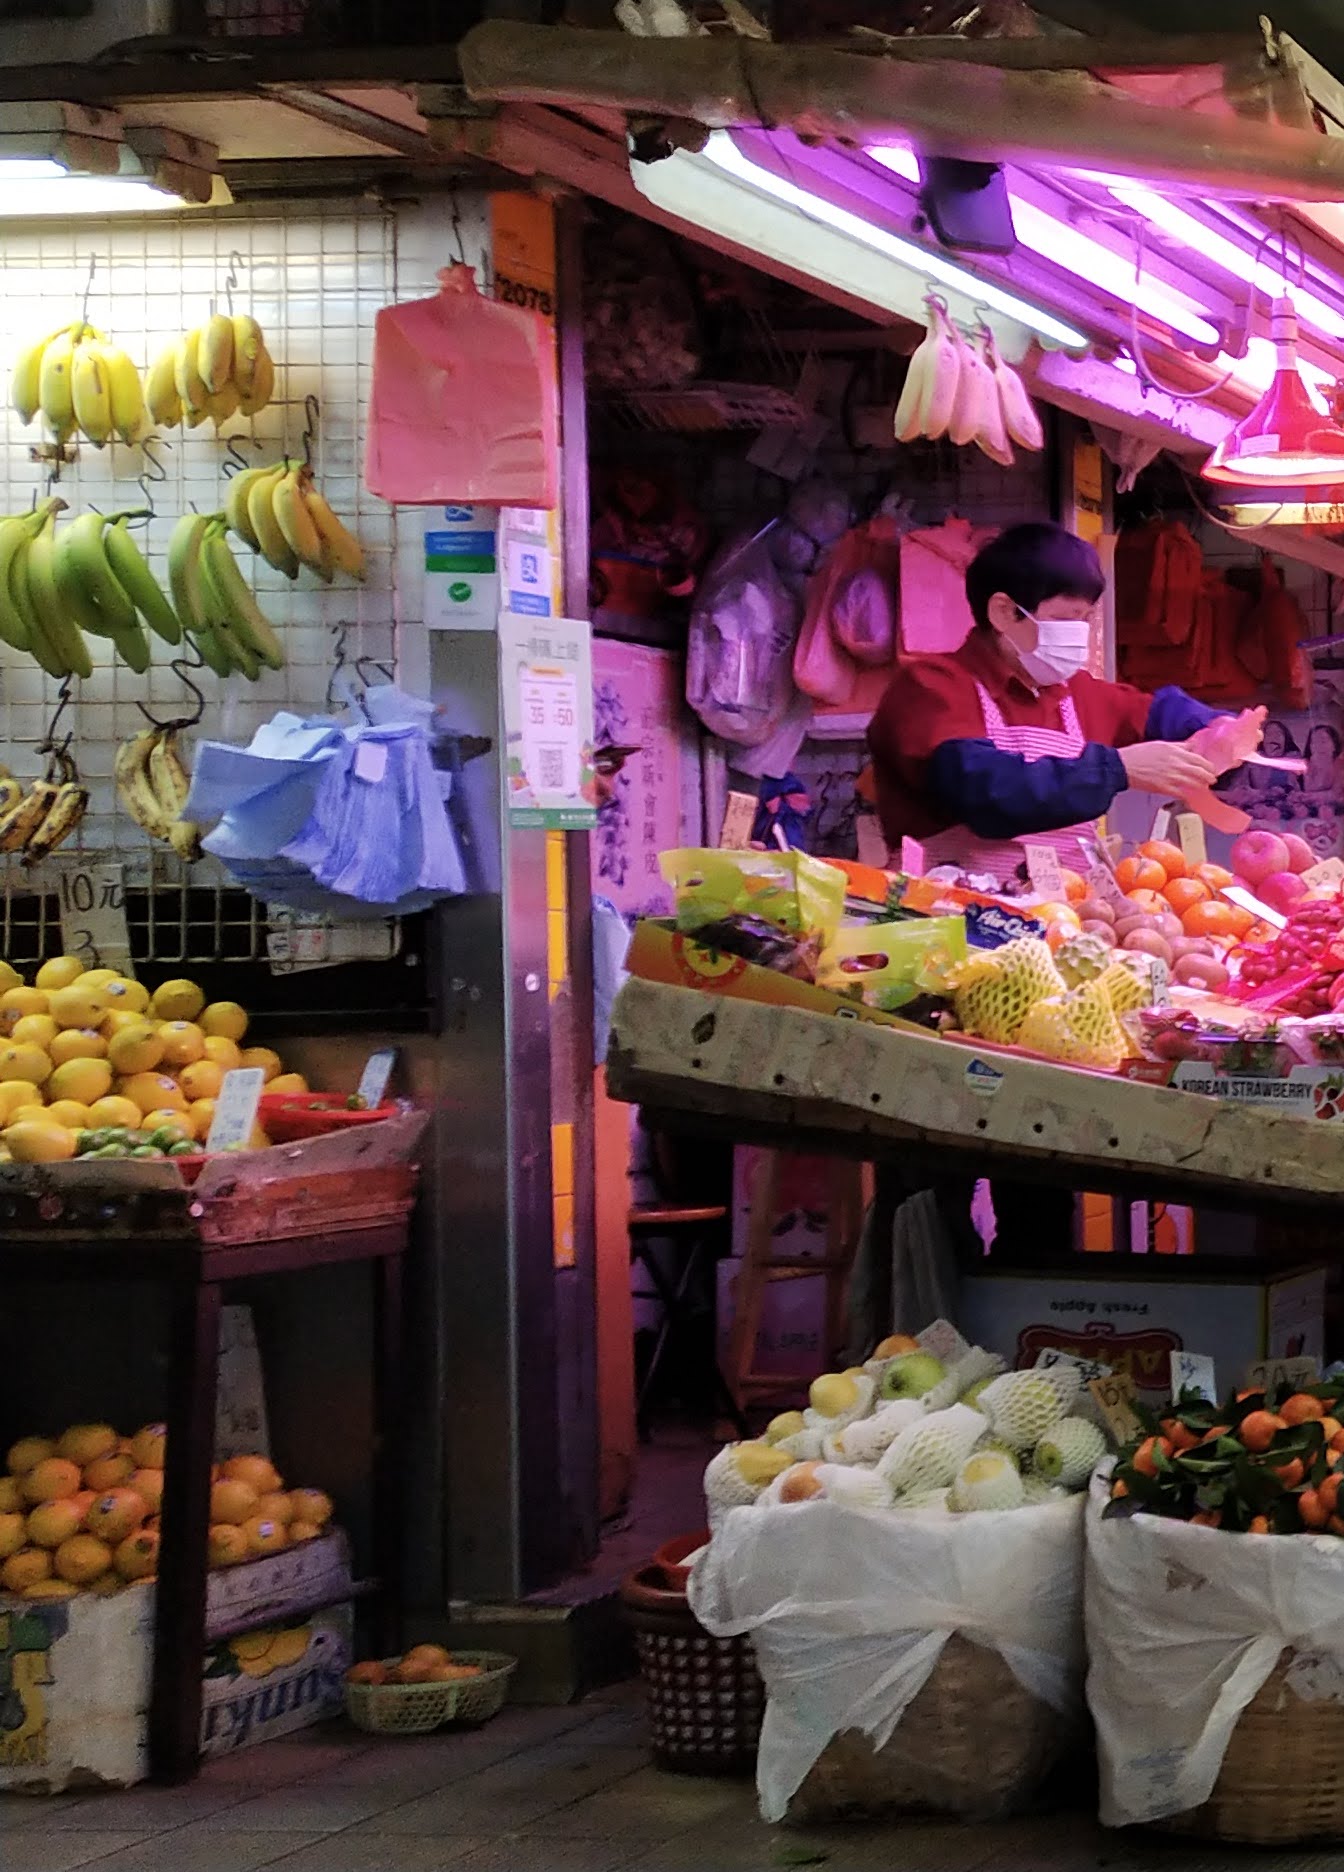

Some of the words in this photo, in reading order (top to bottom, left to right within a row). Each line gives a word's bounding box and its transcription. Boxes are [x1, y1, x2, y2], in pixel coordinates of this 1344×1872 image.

[62, 872, 123, 912] 10元
[1181, 1079, 1229, 1098] KOREAN
[1231, 1080, 1313, 1101] STRAWBERRY
[1049, 1299, 1097, 1314] Apple
[1103, 1301, 1149, 1316] Fresh
